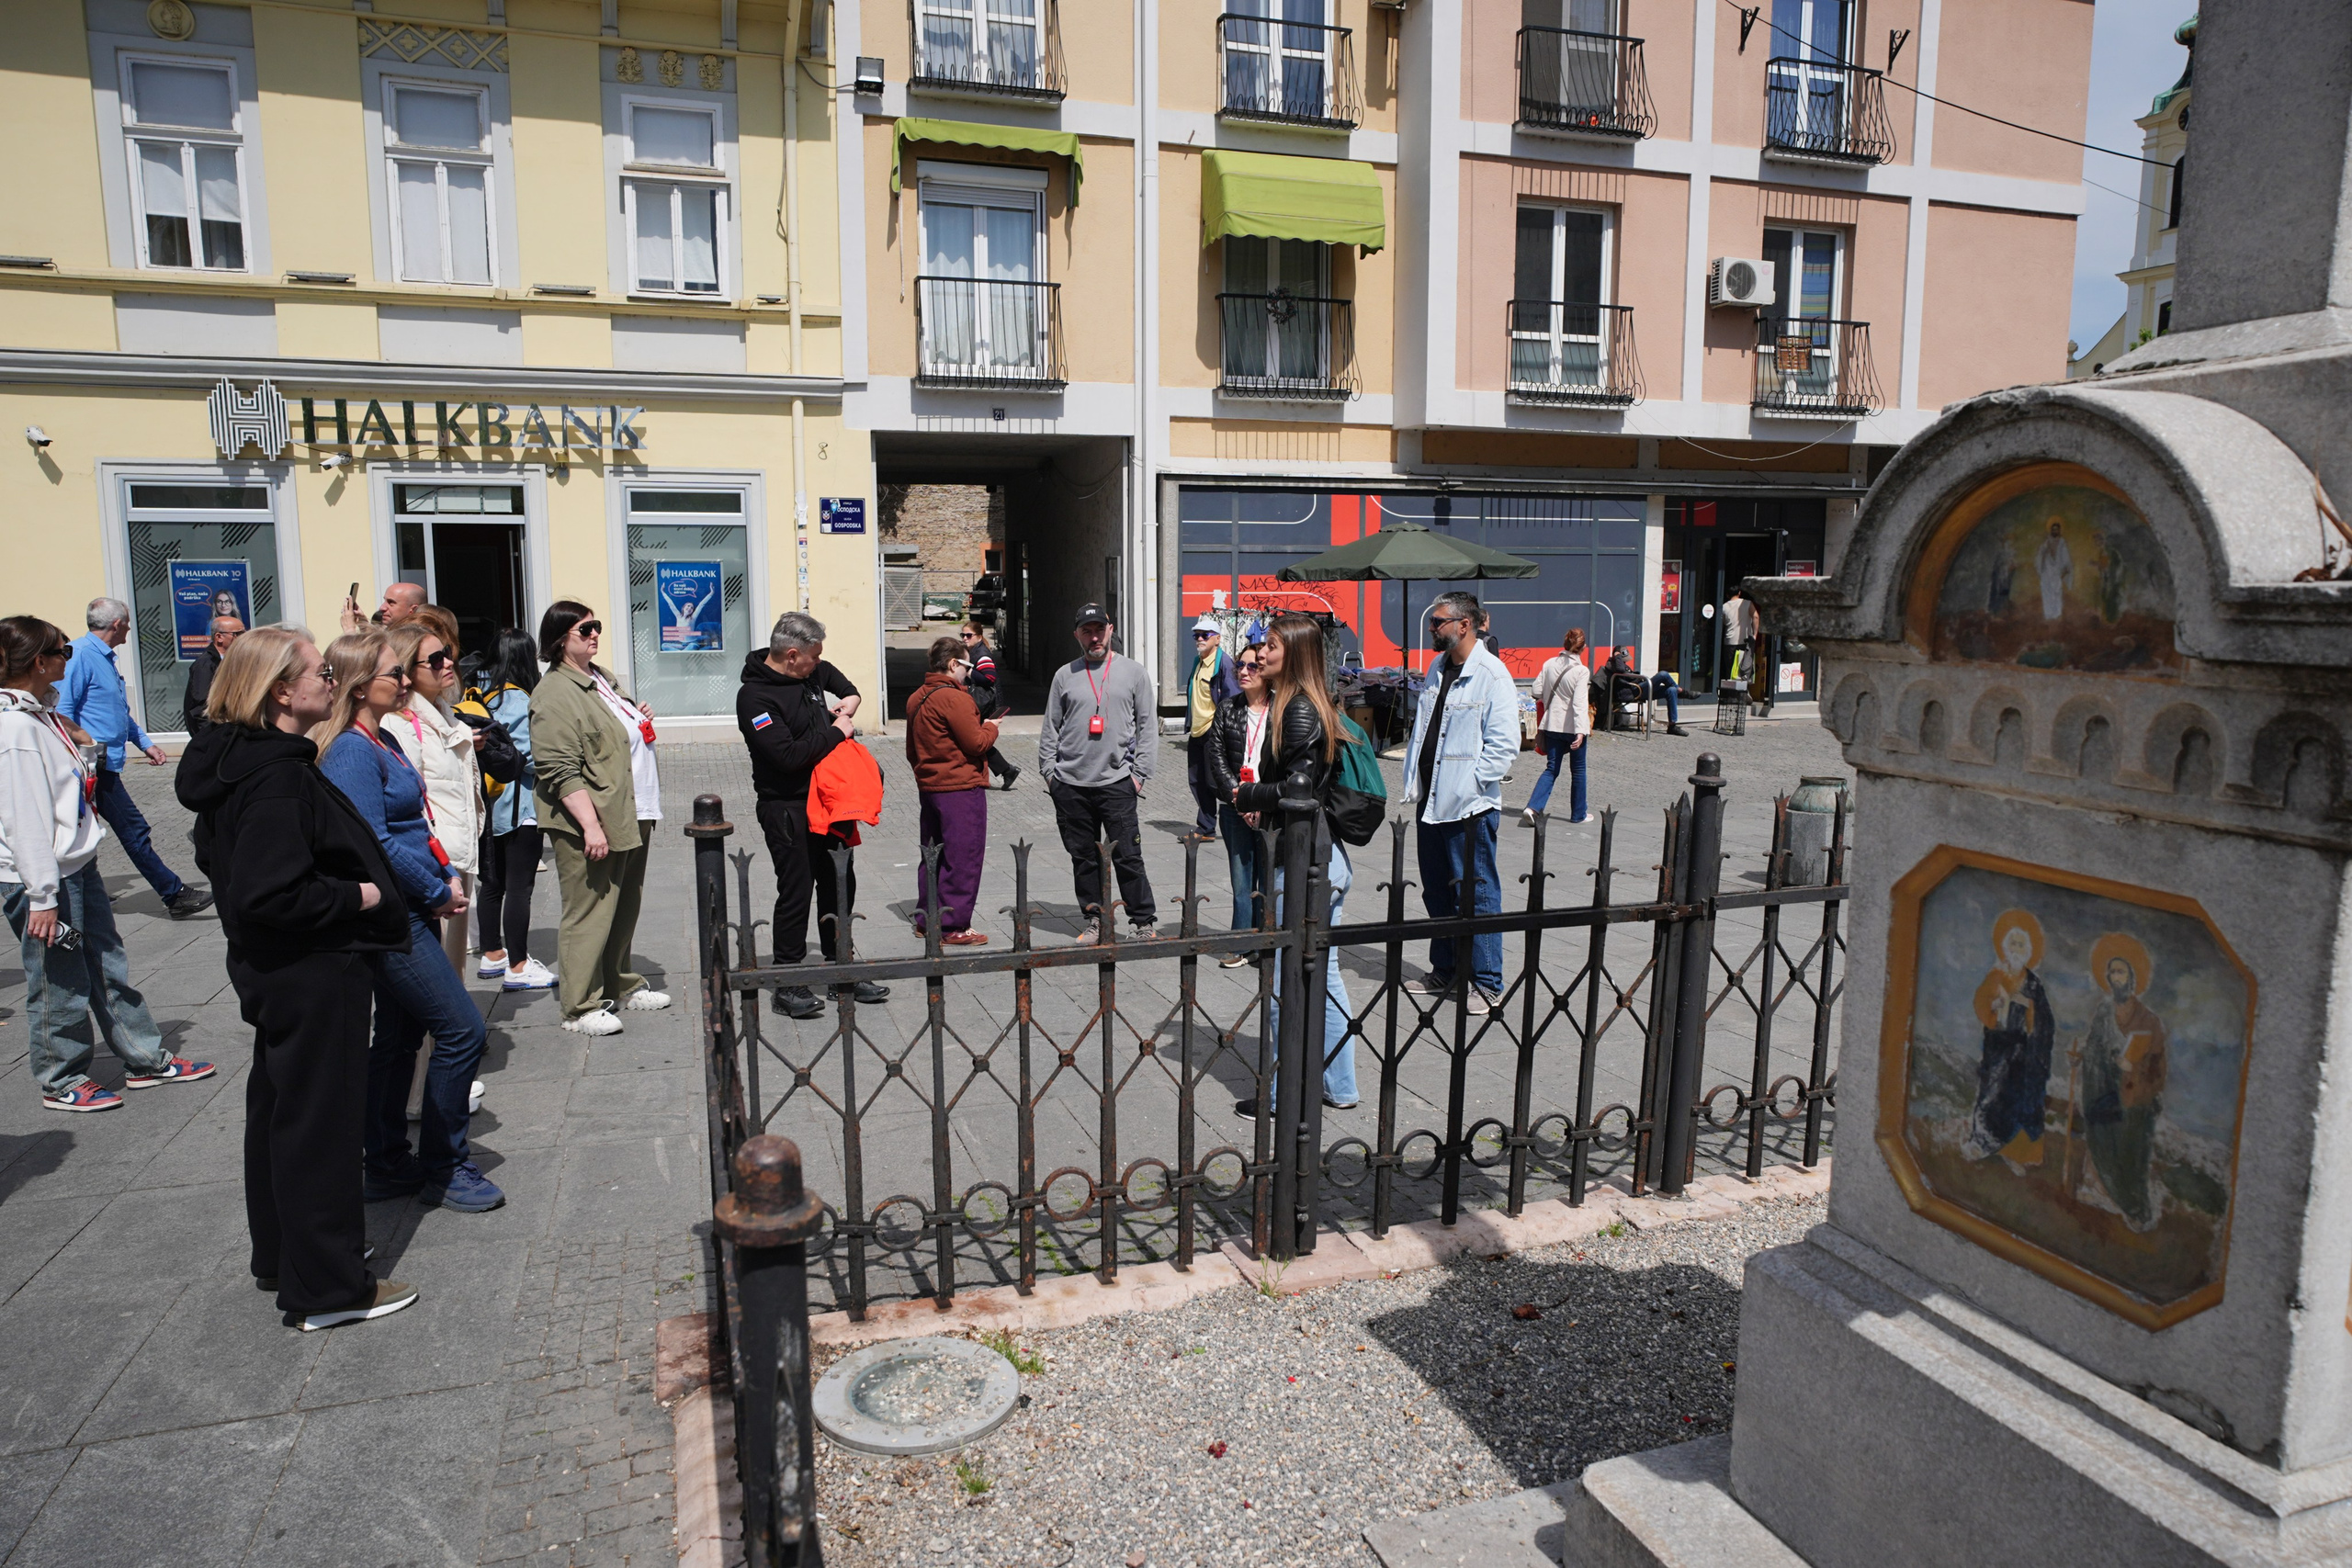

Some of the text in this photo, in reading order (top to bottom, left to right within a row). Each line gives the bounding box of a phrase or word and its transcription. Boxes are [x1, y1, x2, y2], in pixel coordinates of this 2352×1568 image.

[994, 410, 1003, 420] 21
[300, 397, 648, 451] HALKBANK
[671, 570, 717, 578] HALKBANK
